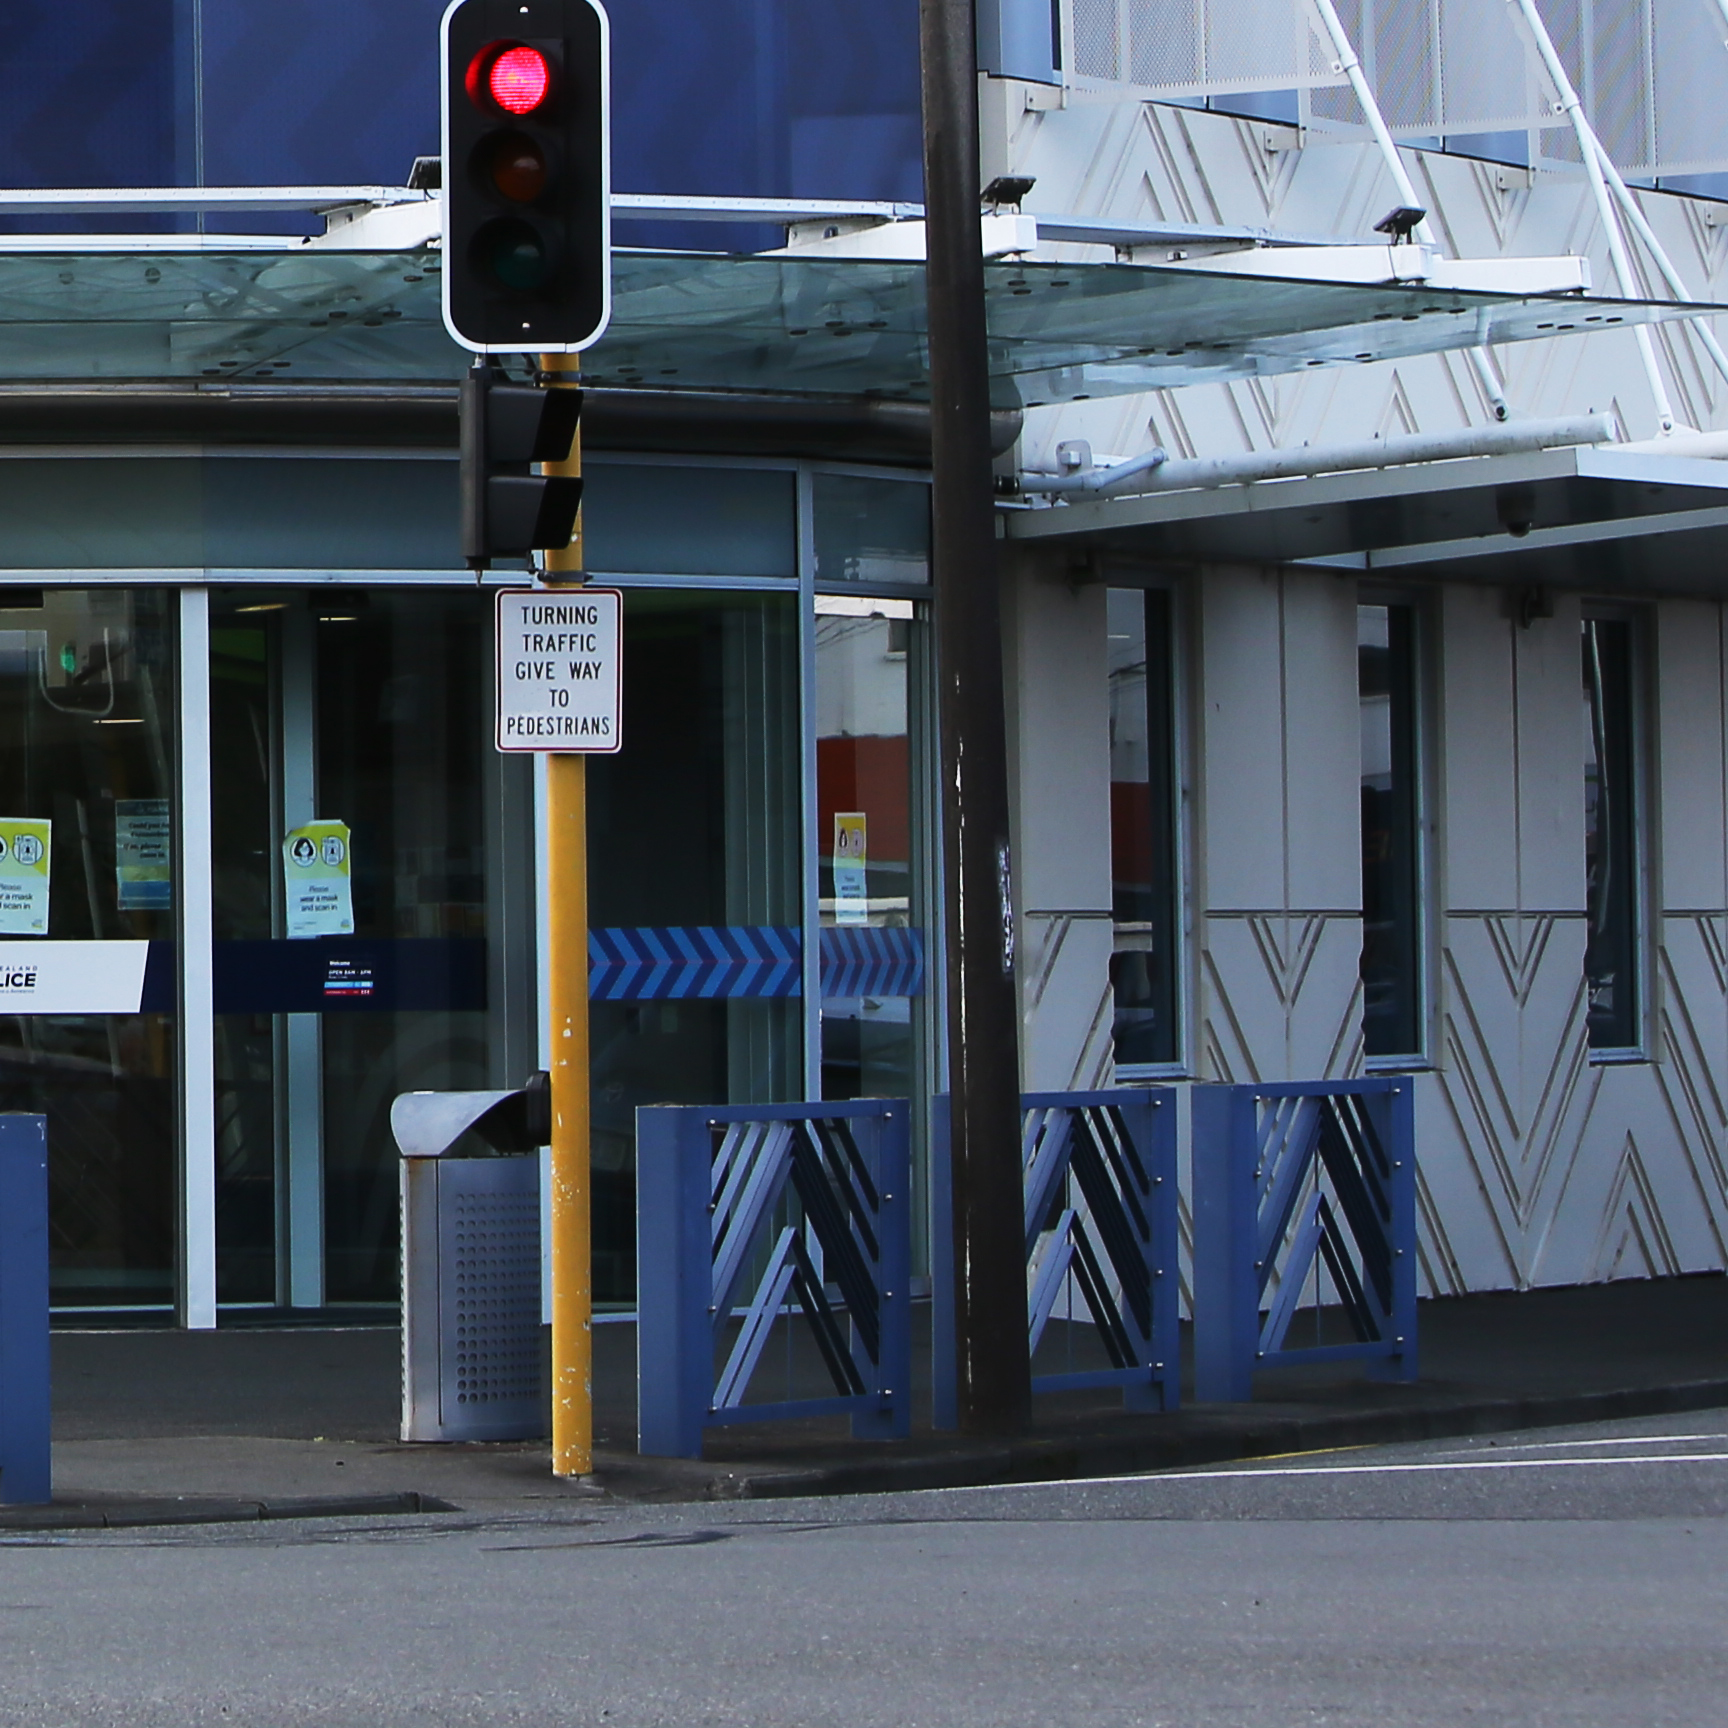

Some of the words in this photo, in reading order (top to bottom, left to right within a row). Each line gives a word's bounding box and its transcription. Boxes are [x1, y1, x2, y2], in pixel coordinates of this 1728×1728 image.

[521, 606, 598, 625] TURNING
[522, 633, 597, 652] TRAFFIC
[515, 661, 555, 680] GIVE
[569, 661, 602, 680] WAY
[549, 688, 569, 708] TO
[507, 716, 610, 736] PEDESTRIANS
[11, 892, 33, 900] mask
[23, 902, 31, 910] in
